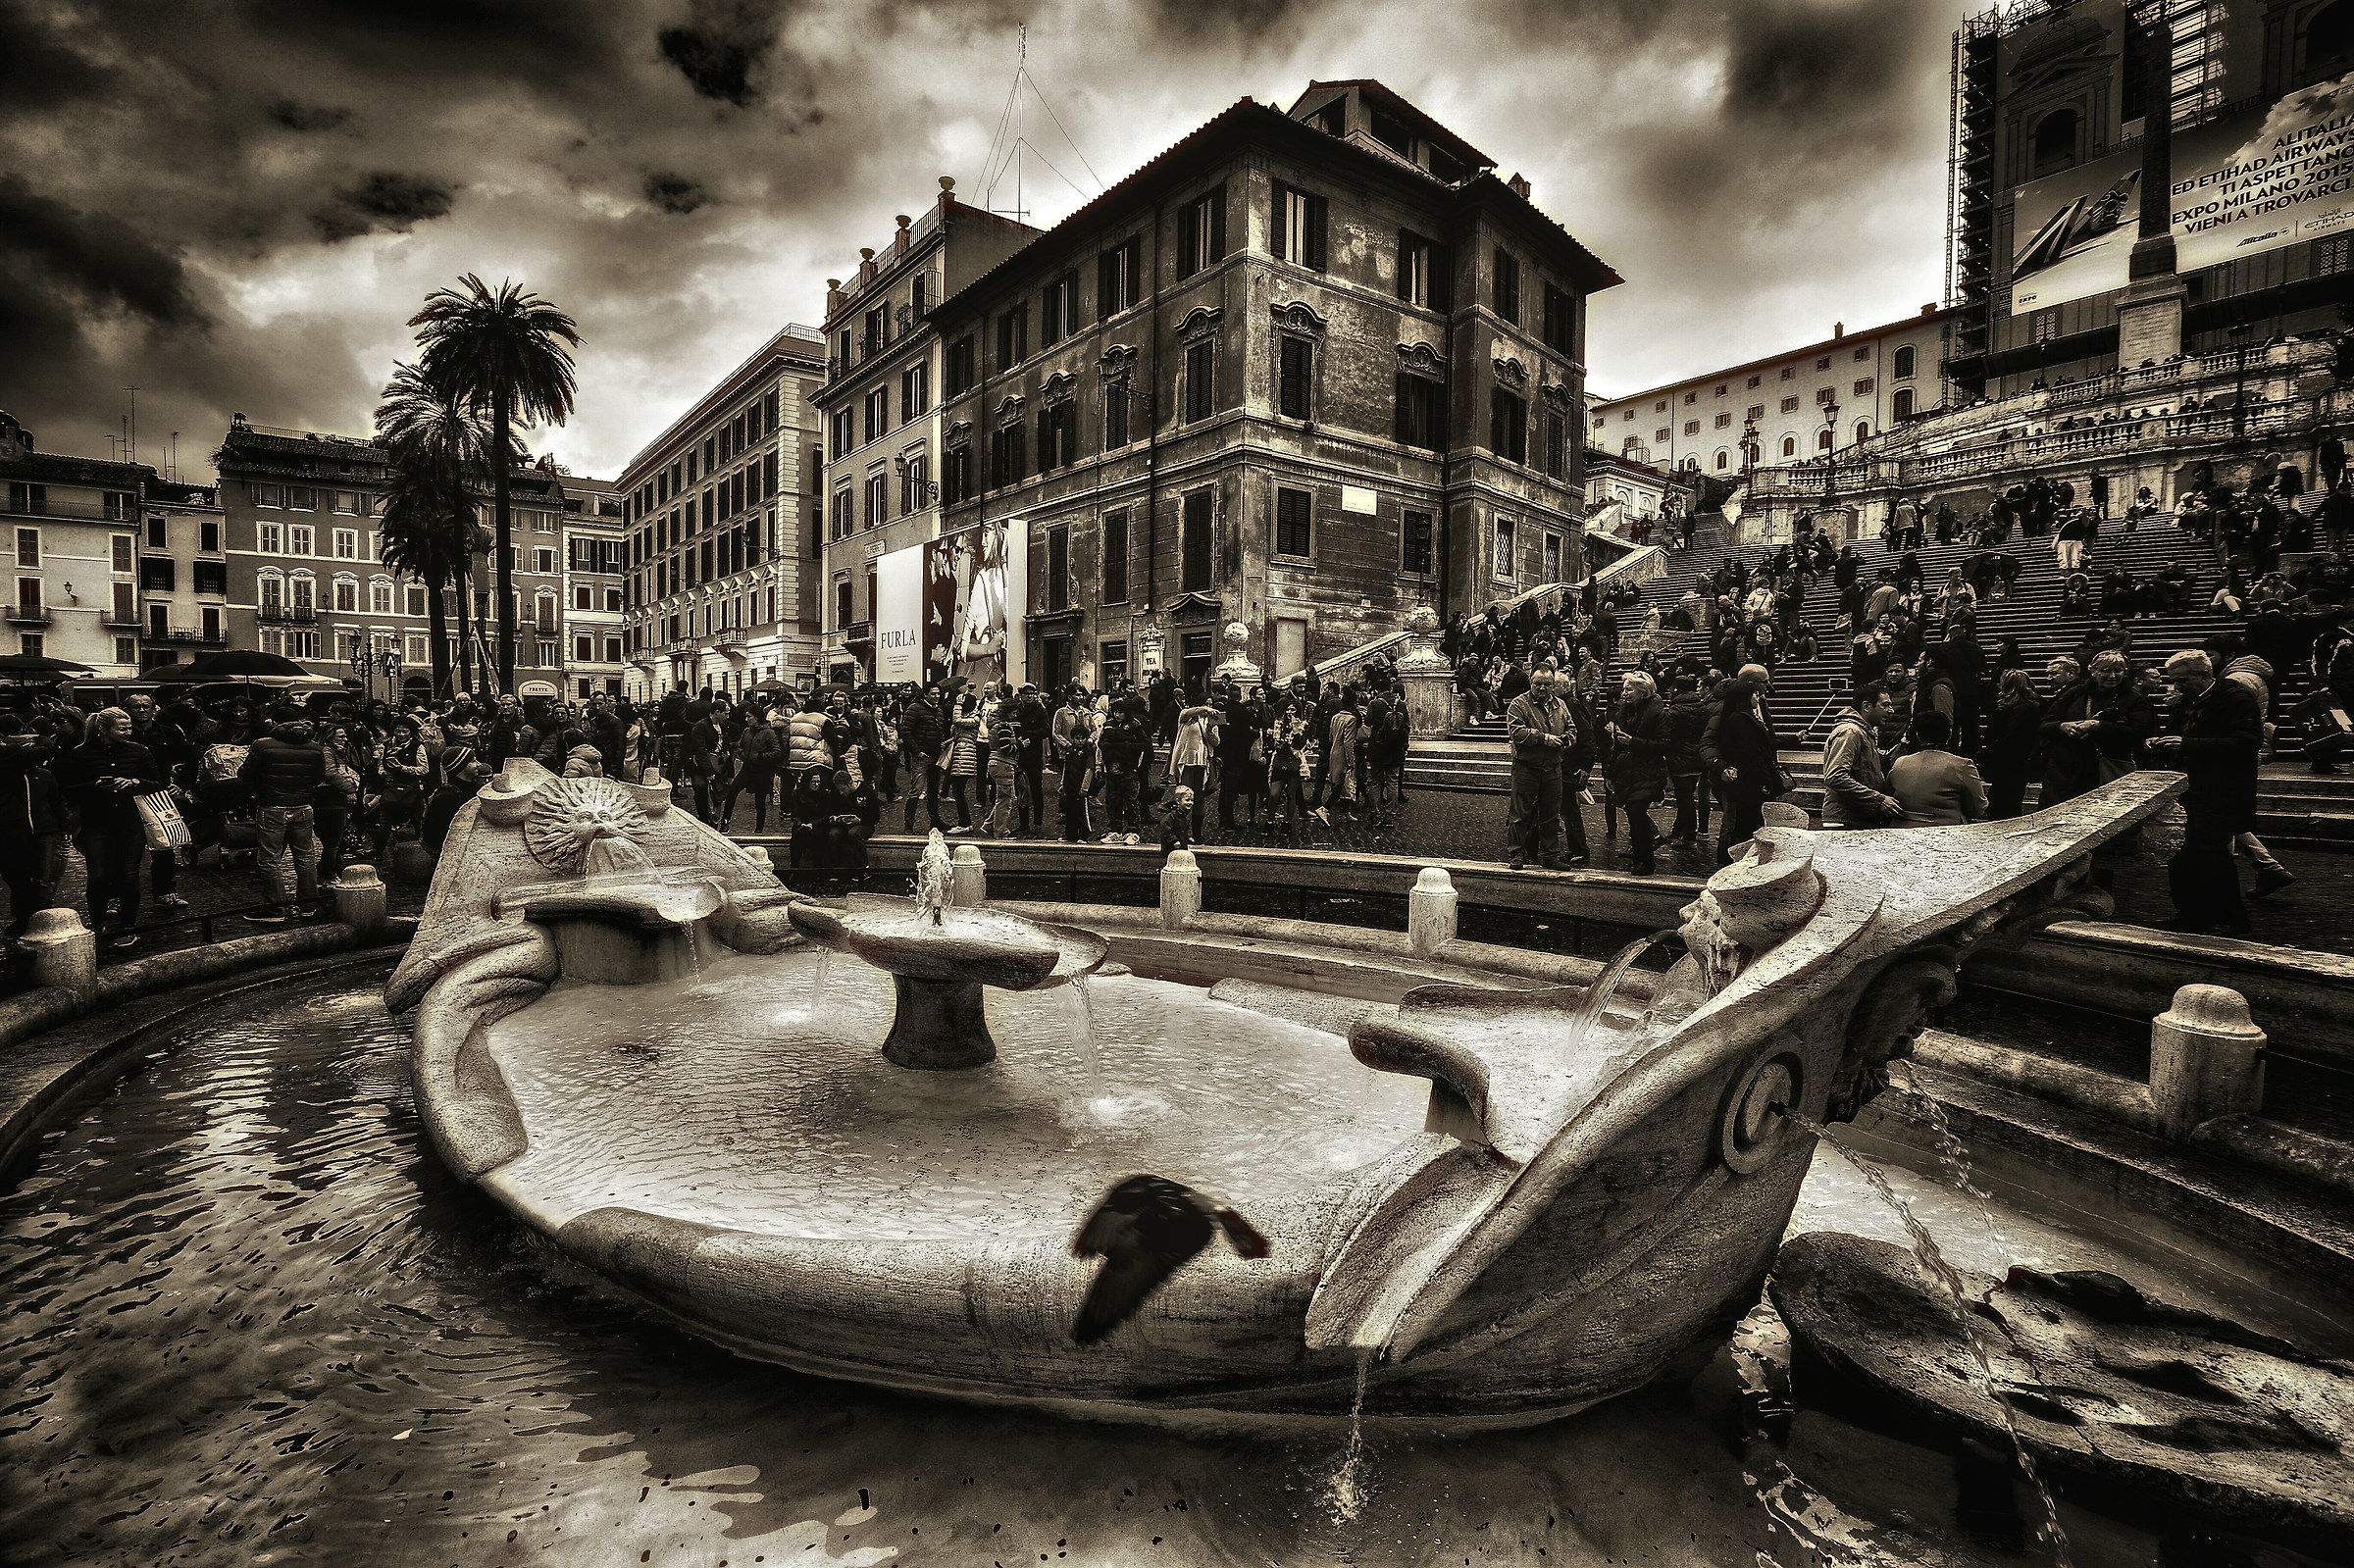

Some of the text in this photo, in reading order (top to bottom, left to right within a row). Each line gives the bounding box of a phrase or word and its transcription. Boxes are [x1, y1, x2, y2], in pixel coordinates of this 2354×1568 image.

[2173, 128, 2354, 196] ED ETIHAD AIRWAYS
[2219, 144, 2354, 195] TI ASPETTANO
[2173, 202, 2220, 225] EXPO
[2224, 178, 2300, 210] MILANO
[2185, 212, 2231, 233] VIENI
[2235, 209, 2249, 222] A
[881, 630, 916, 649] FURLA
